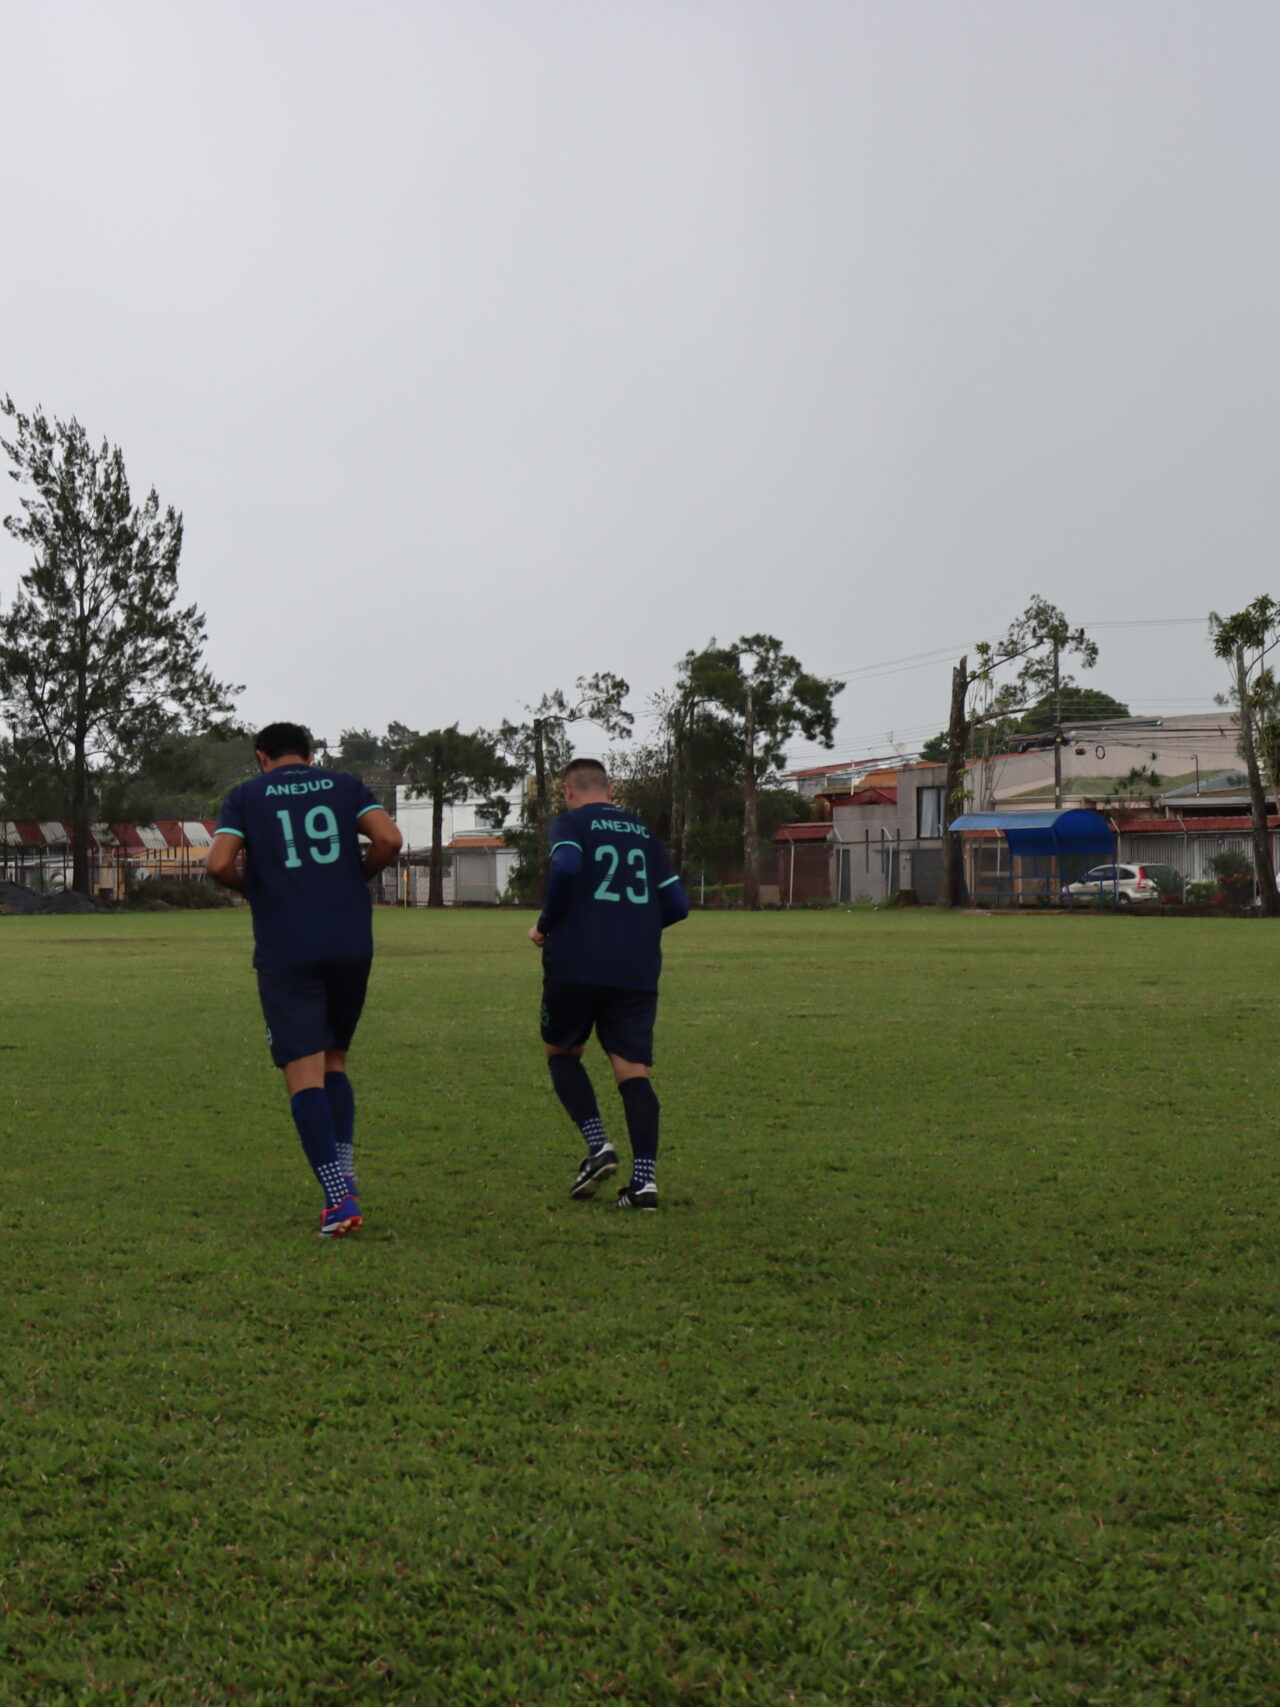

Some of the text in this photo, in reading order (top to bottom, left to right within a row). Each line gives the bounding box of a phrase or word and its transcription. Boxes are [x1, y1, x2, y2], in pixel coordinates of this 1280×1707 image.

[265, 778, 334, 797] ANEJUD
[276, 805, 340, 868] 19
[593, 844, 649, 904] 23
